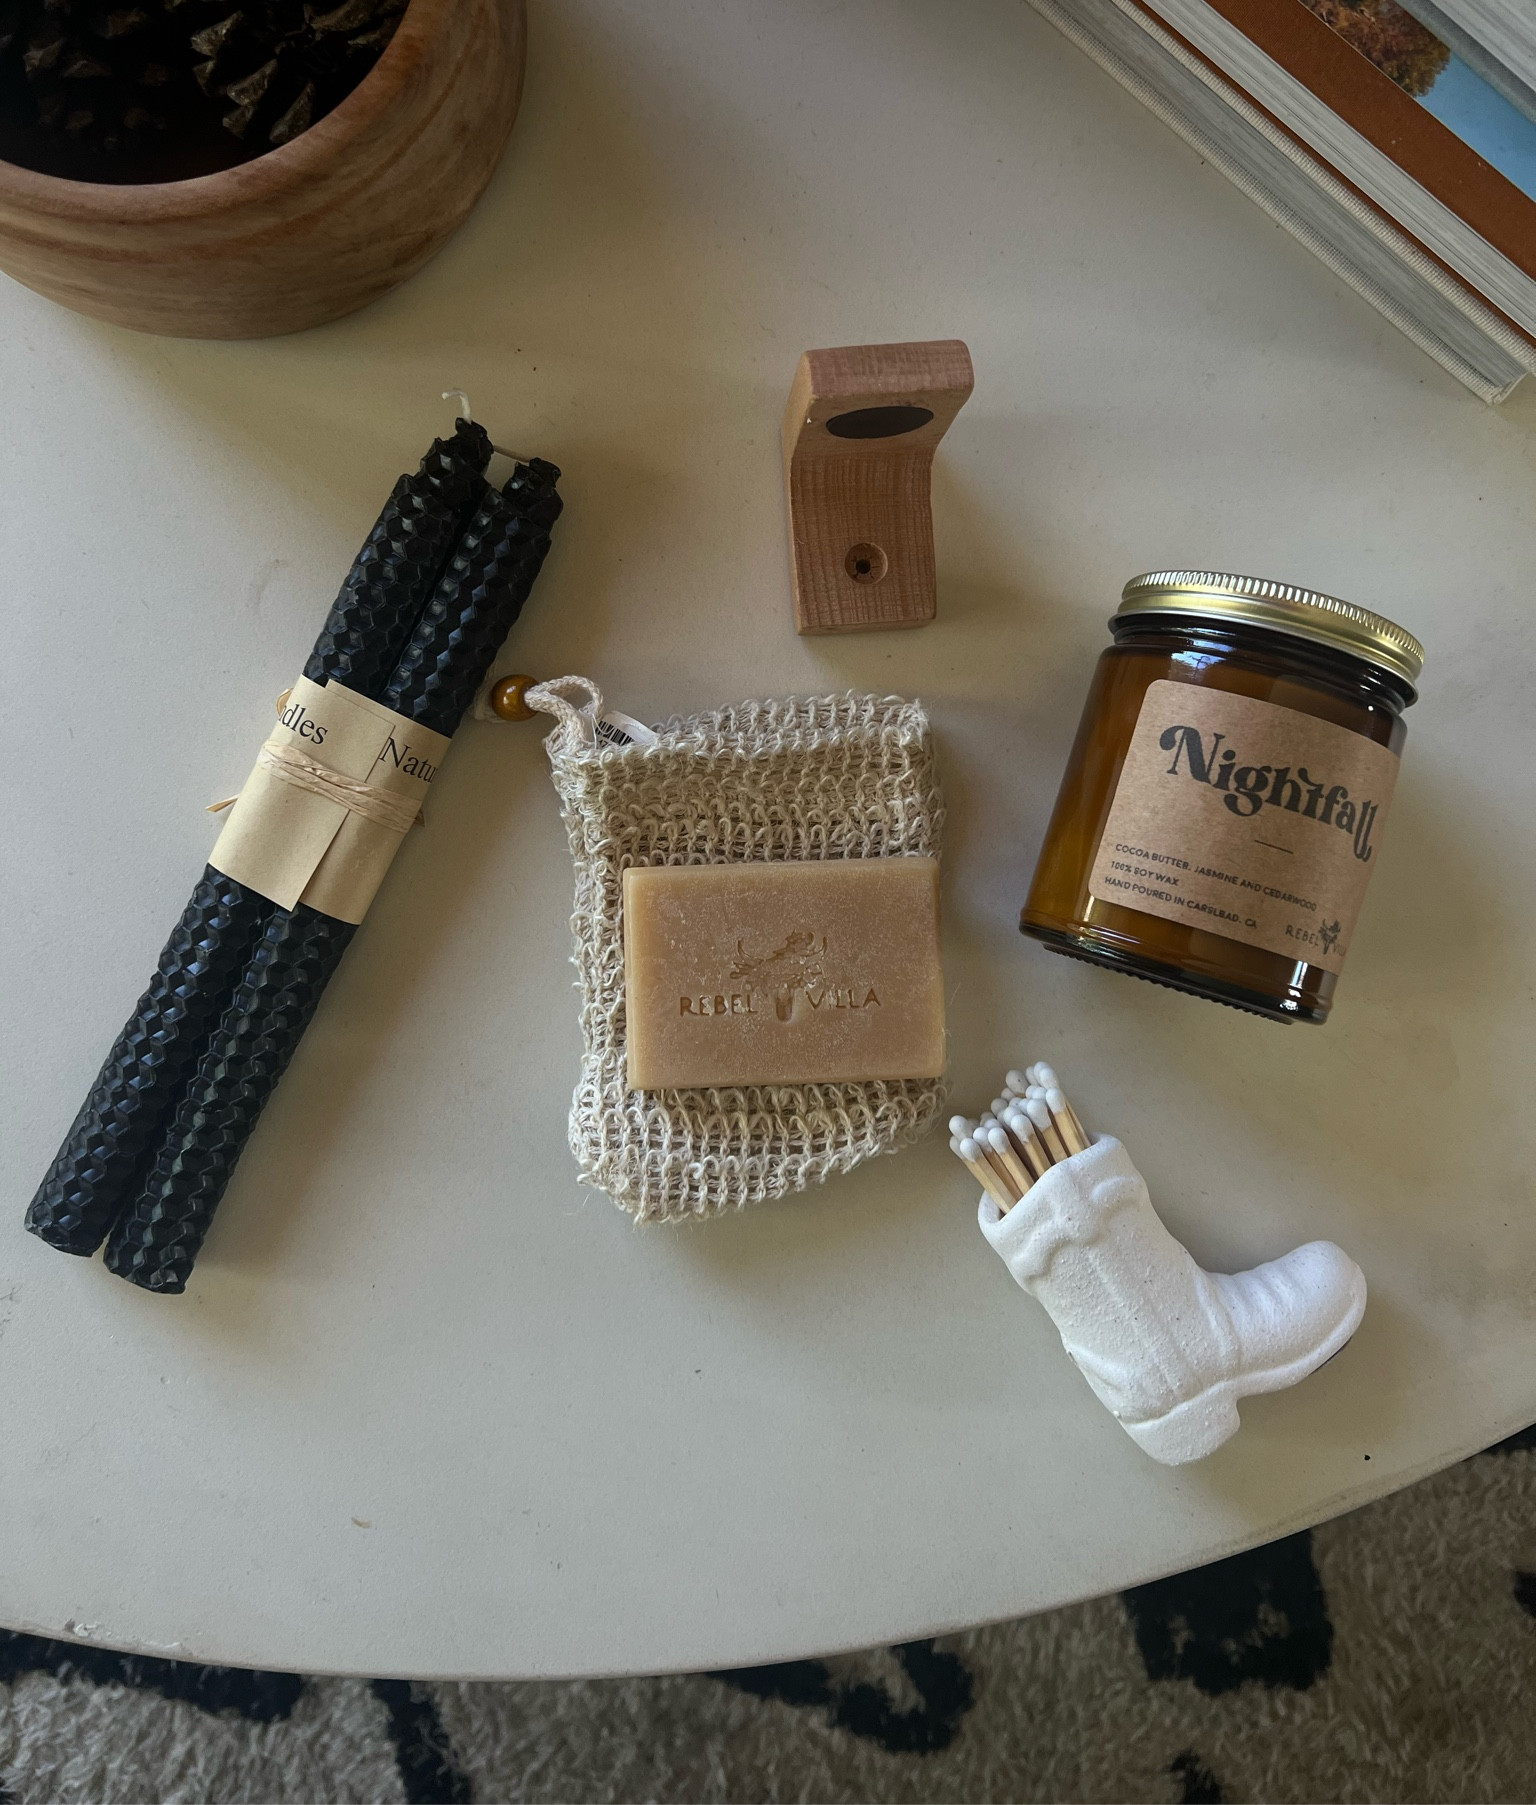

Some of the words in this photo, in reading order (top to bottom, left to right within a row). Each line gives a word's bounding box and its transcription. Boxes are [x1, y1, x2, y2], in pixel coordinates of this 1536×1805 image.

[1160, 725, 1378, 862] Nightfall
[1111, 861, 1132, 872] 100%
[1134, 867, 1154, 878] SOY
[1155, 873, 1179, 886] WAX
[1116, 844, 1149, 859] COCOA
[1194, 866, 1239, 885] JASMINE
[1240, 879, 1262, 892] AND
[1263, 887, 1317, 912] CEDARWOOD
[1105, 876, 1131, 889] HAND
[1132, 884, 1172, 901] POURED
[1174, 893, 1185, 905] IN
[1245, 917, 1257, 928] CA
[1285, 924, 1319, 947] REBEL
[679, 994, 759, 1016] REBEL
[805, 988, 881, 1010] VILLA
